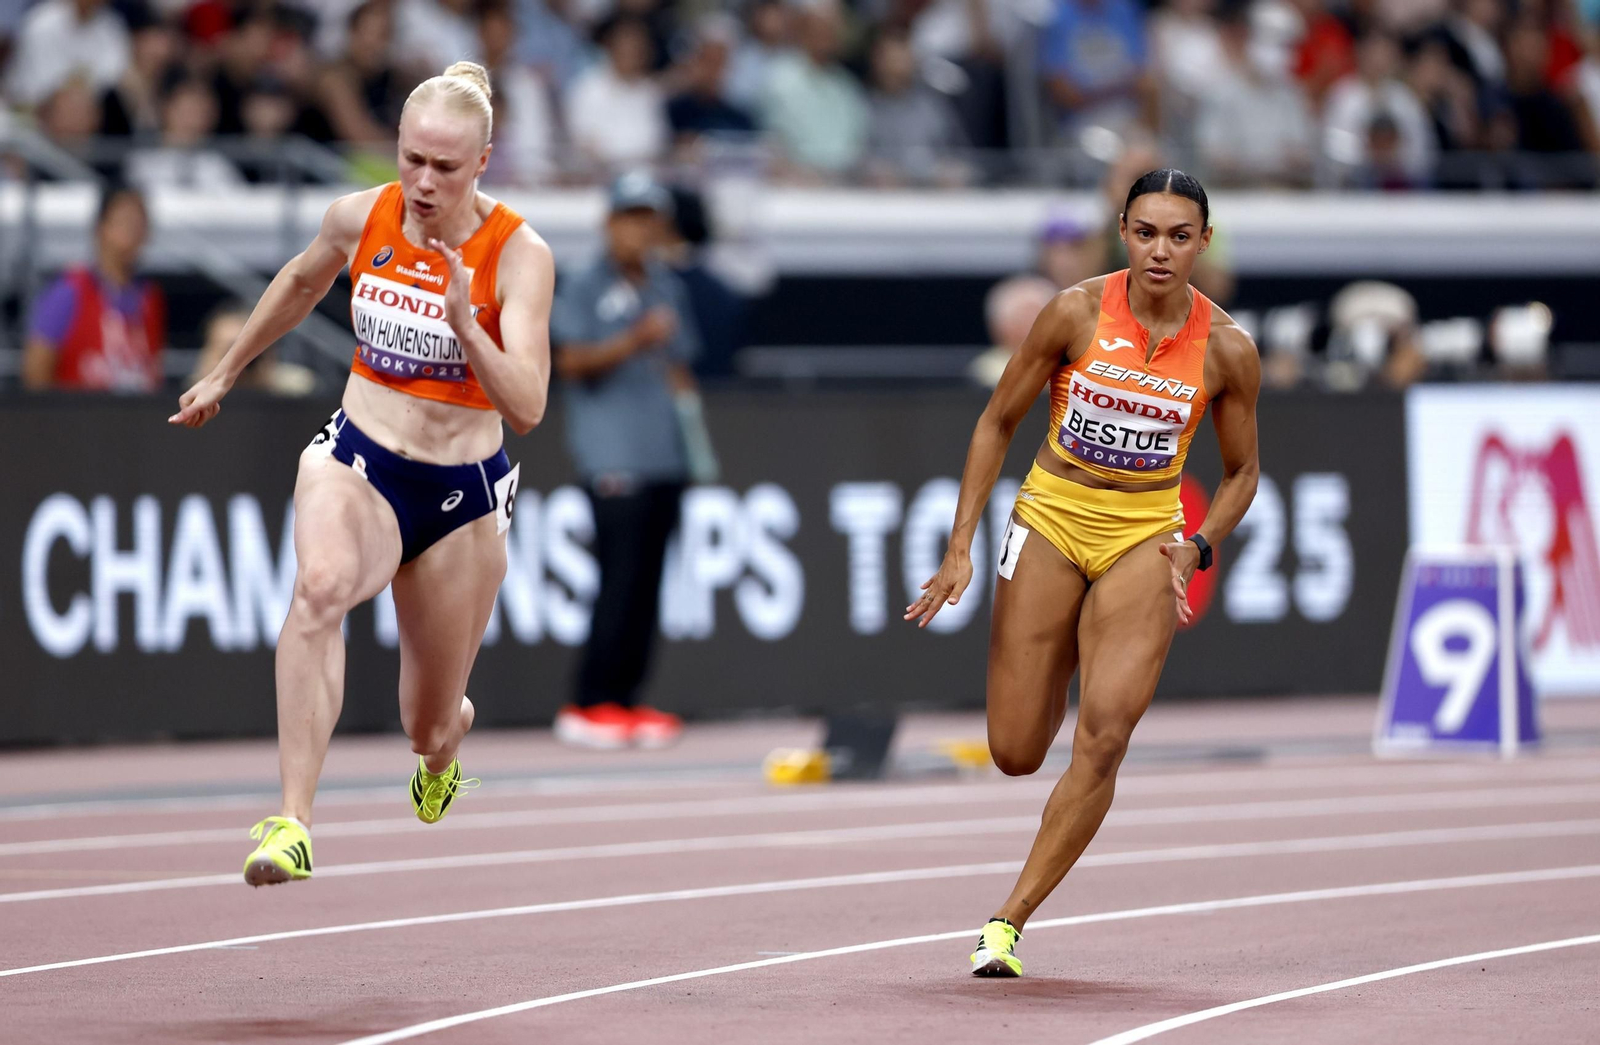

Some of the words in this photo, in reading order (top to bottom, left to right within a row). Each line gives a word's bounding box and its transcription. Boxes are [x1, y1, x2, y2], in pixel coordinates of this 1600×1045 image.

[395, 264, 444, 286] Staatsloterij
[357, 282, 446, 323] HOND
[355, 310, 377, 343] VAN
[376, 318, 463, 361] HUNENSTIJN
[1085, 360, 1198, 401] ESPAÑA
[1071, 380, 1184, 425] HONDA
[1411, 600, 1495, 735] 9
